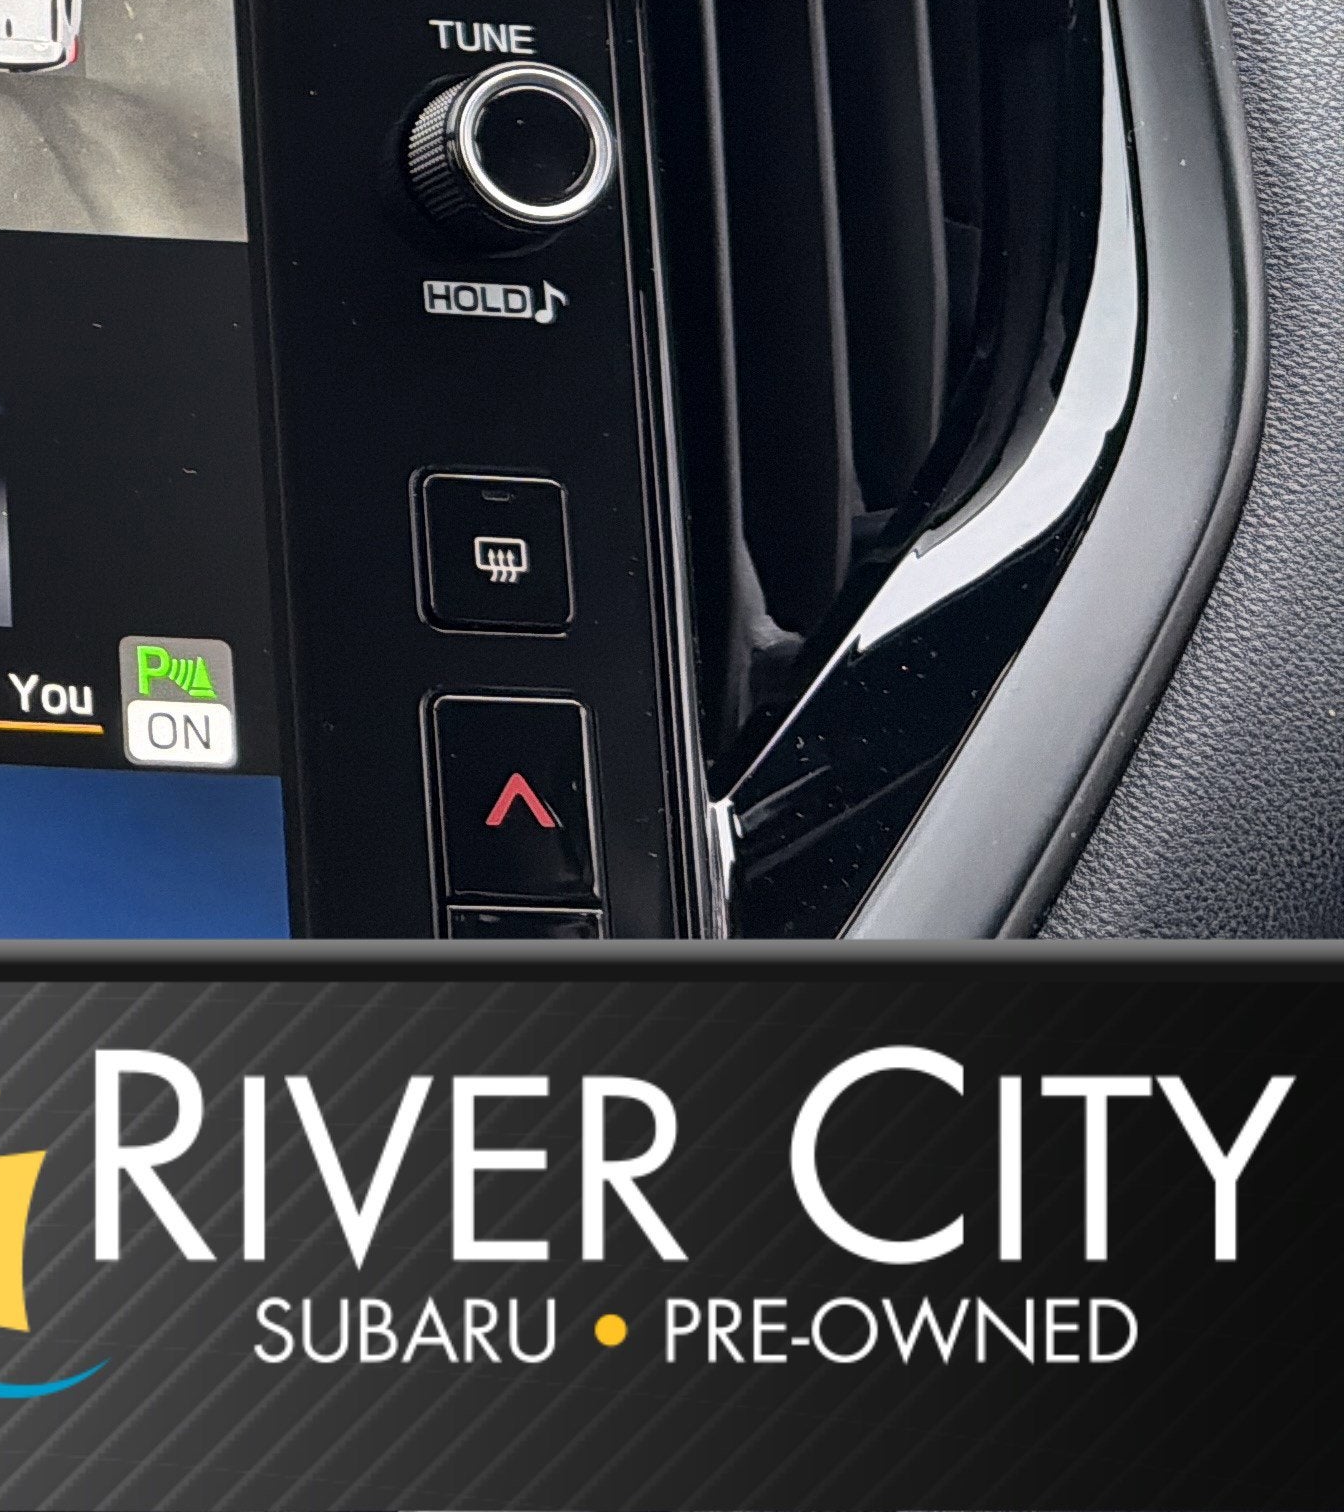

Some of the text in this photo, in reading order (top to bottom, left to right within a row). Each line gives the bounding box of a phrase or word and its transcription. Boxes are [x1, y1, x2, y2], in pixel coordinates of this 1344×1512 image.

[429, 20, 534, 54] TUNE
[426, 284, 530, 316] HOLD
[12, 674, 93, 715] You
[144, 708, 214, 752] ON
